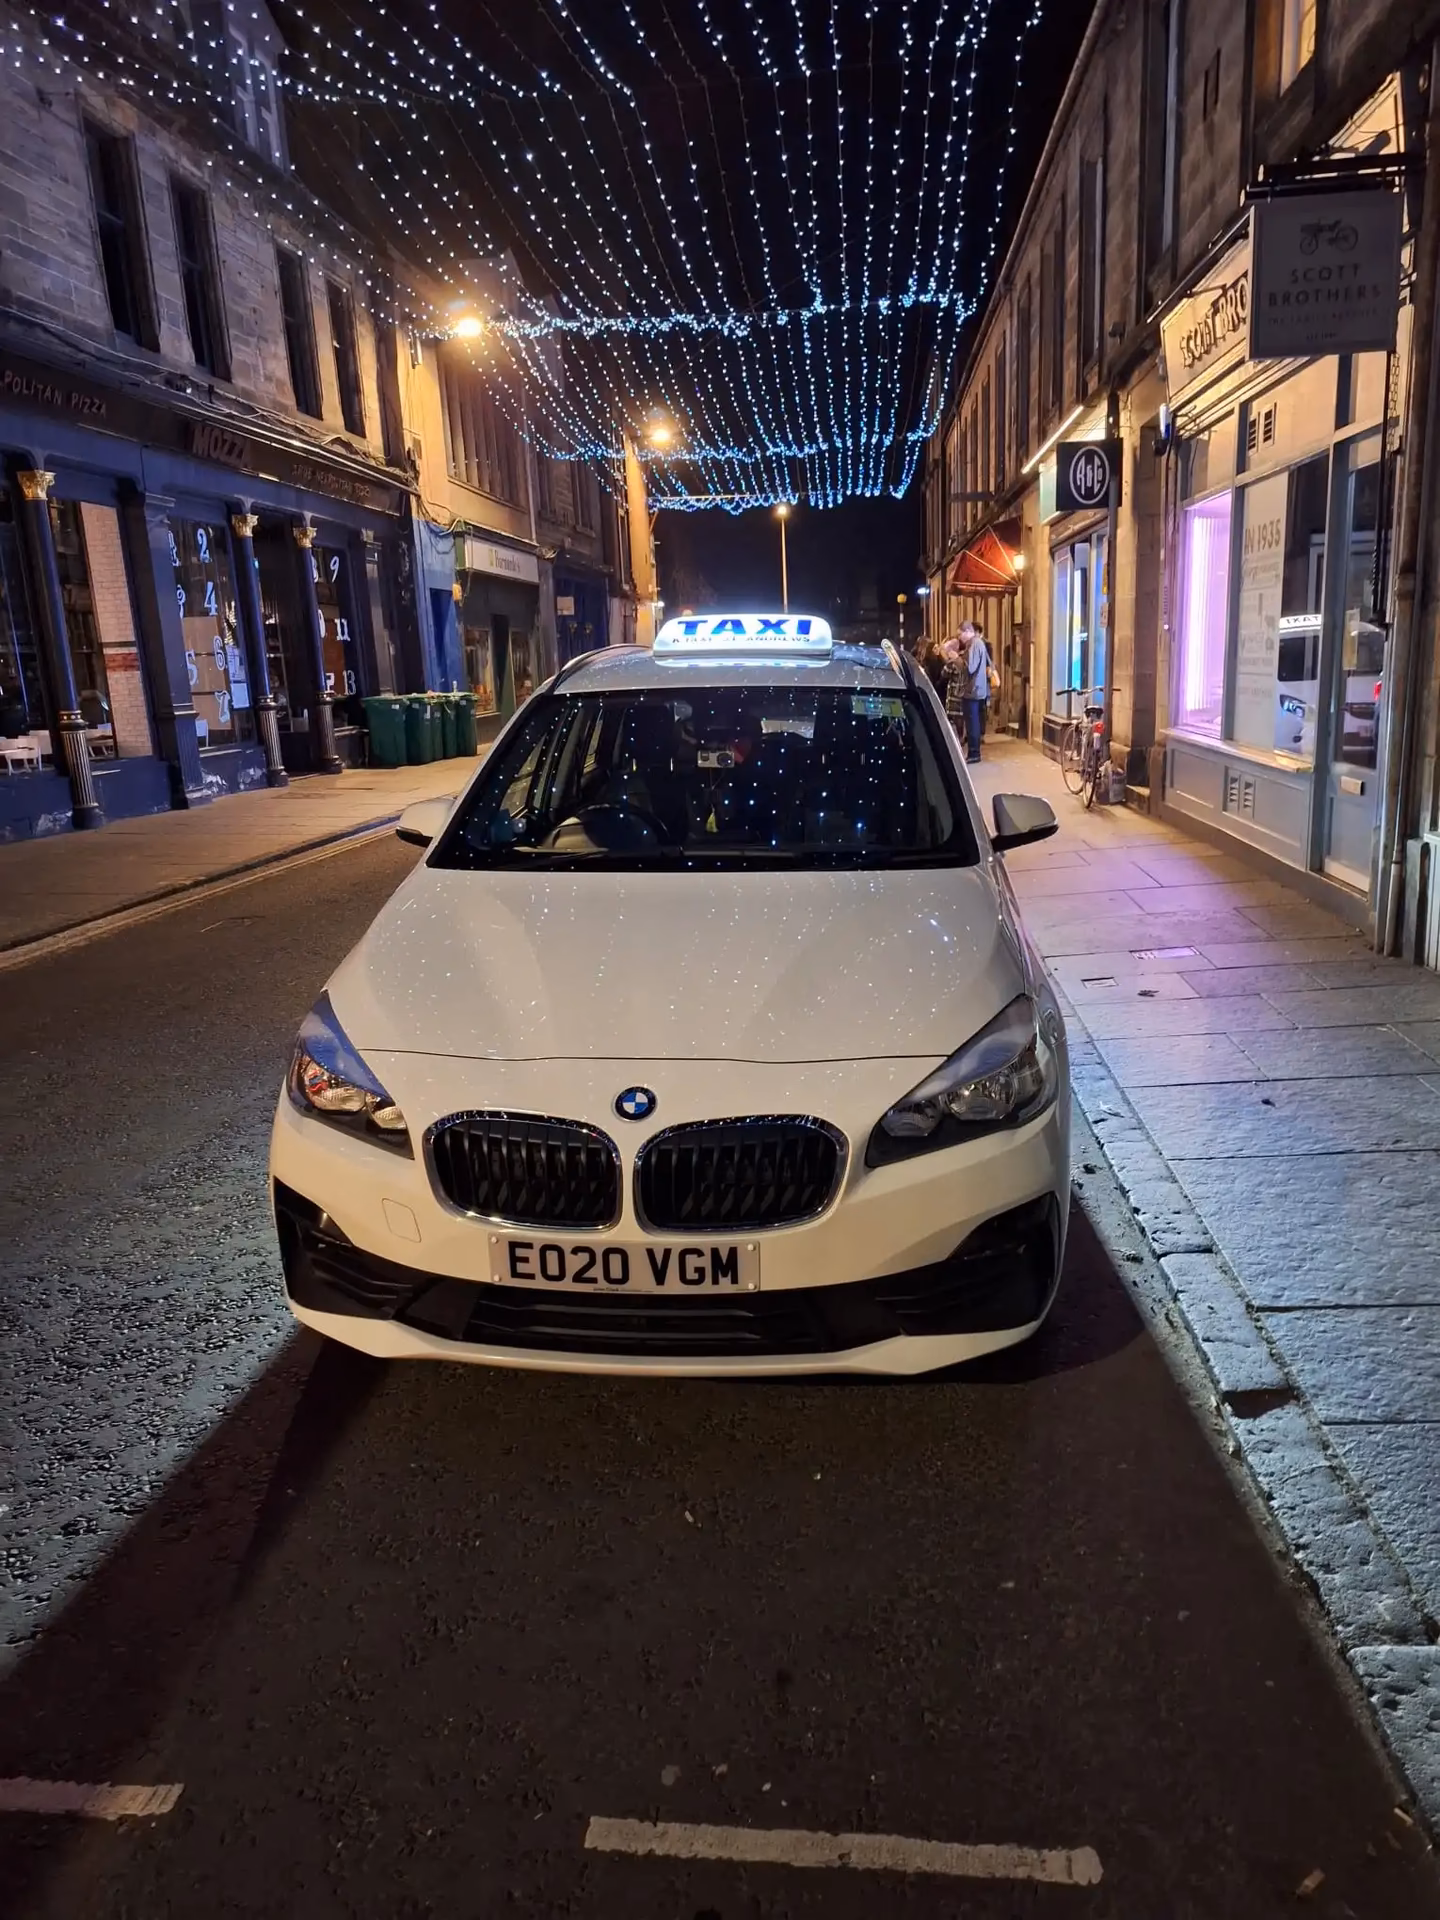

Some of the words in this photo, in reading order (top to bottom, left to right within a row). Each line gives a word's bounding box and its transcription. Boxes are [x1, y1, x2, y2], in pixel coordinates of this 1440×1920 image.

[1290, 263, 1361, 284] SCOTT
[1215, 277, 1248, 340] BRO
[1268, 284, 1382, 307] BROTHERS
[0, 369, 62, 407] POLITAN
[71, 392, 107, 418] PIZZA
[193, 426, 251, 467] MOZZA
[1257, 519, 1282, 550] 1935
[330, 556, 340, 583] 9
[204, 582, 218, 616] 4
[334, 618, 351, 641] 11
[677, 619, 812, 635] TAXI
[342, 670, 357, 695] 13
[215, 690, 230, 724] 7
[508, 1241, 630, 1286] EO20
[645, 1246, 739, 1286] VGM
